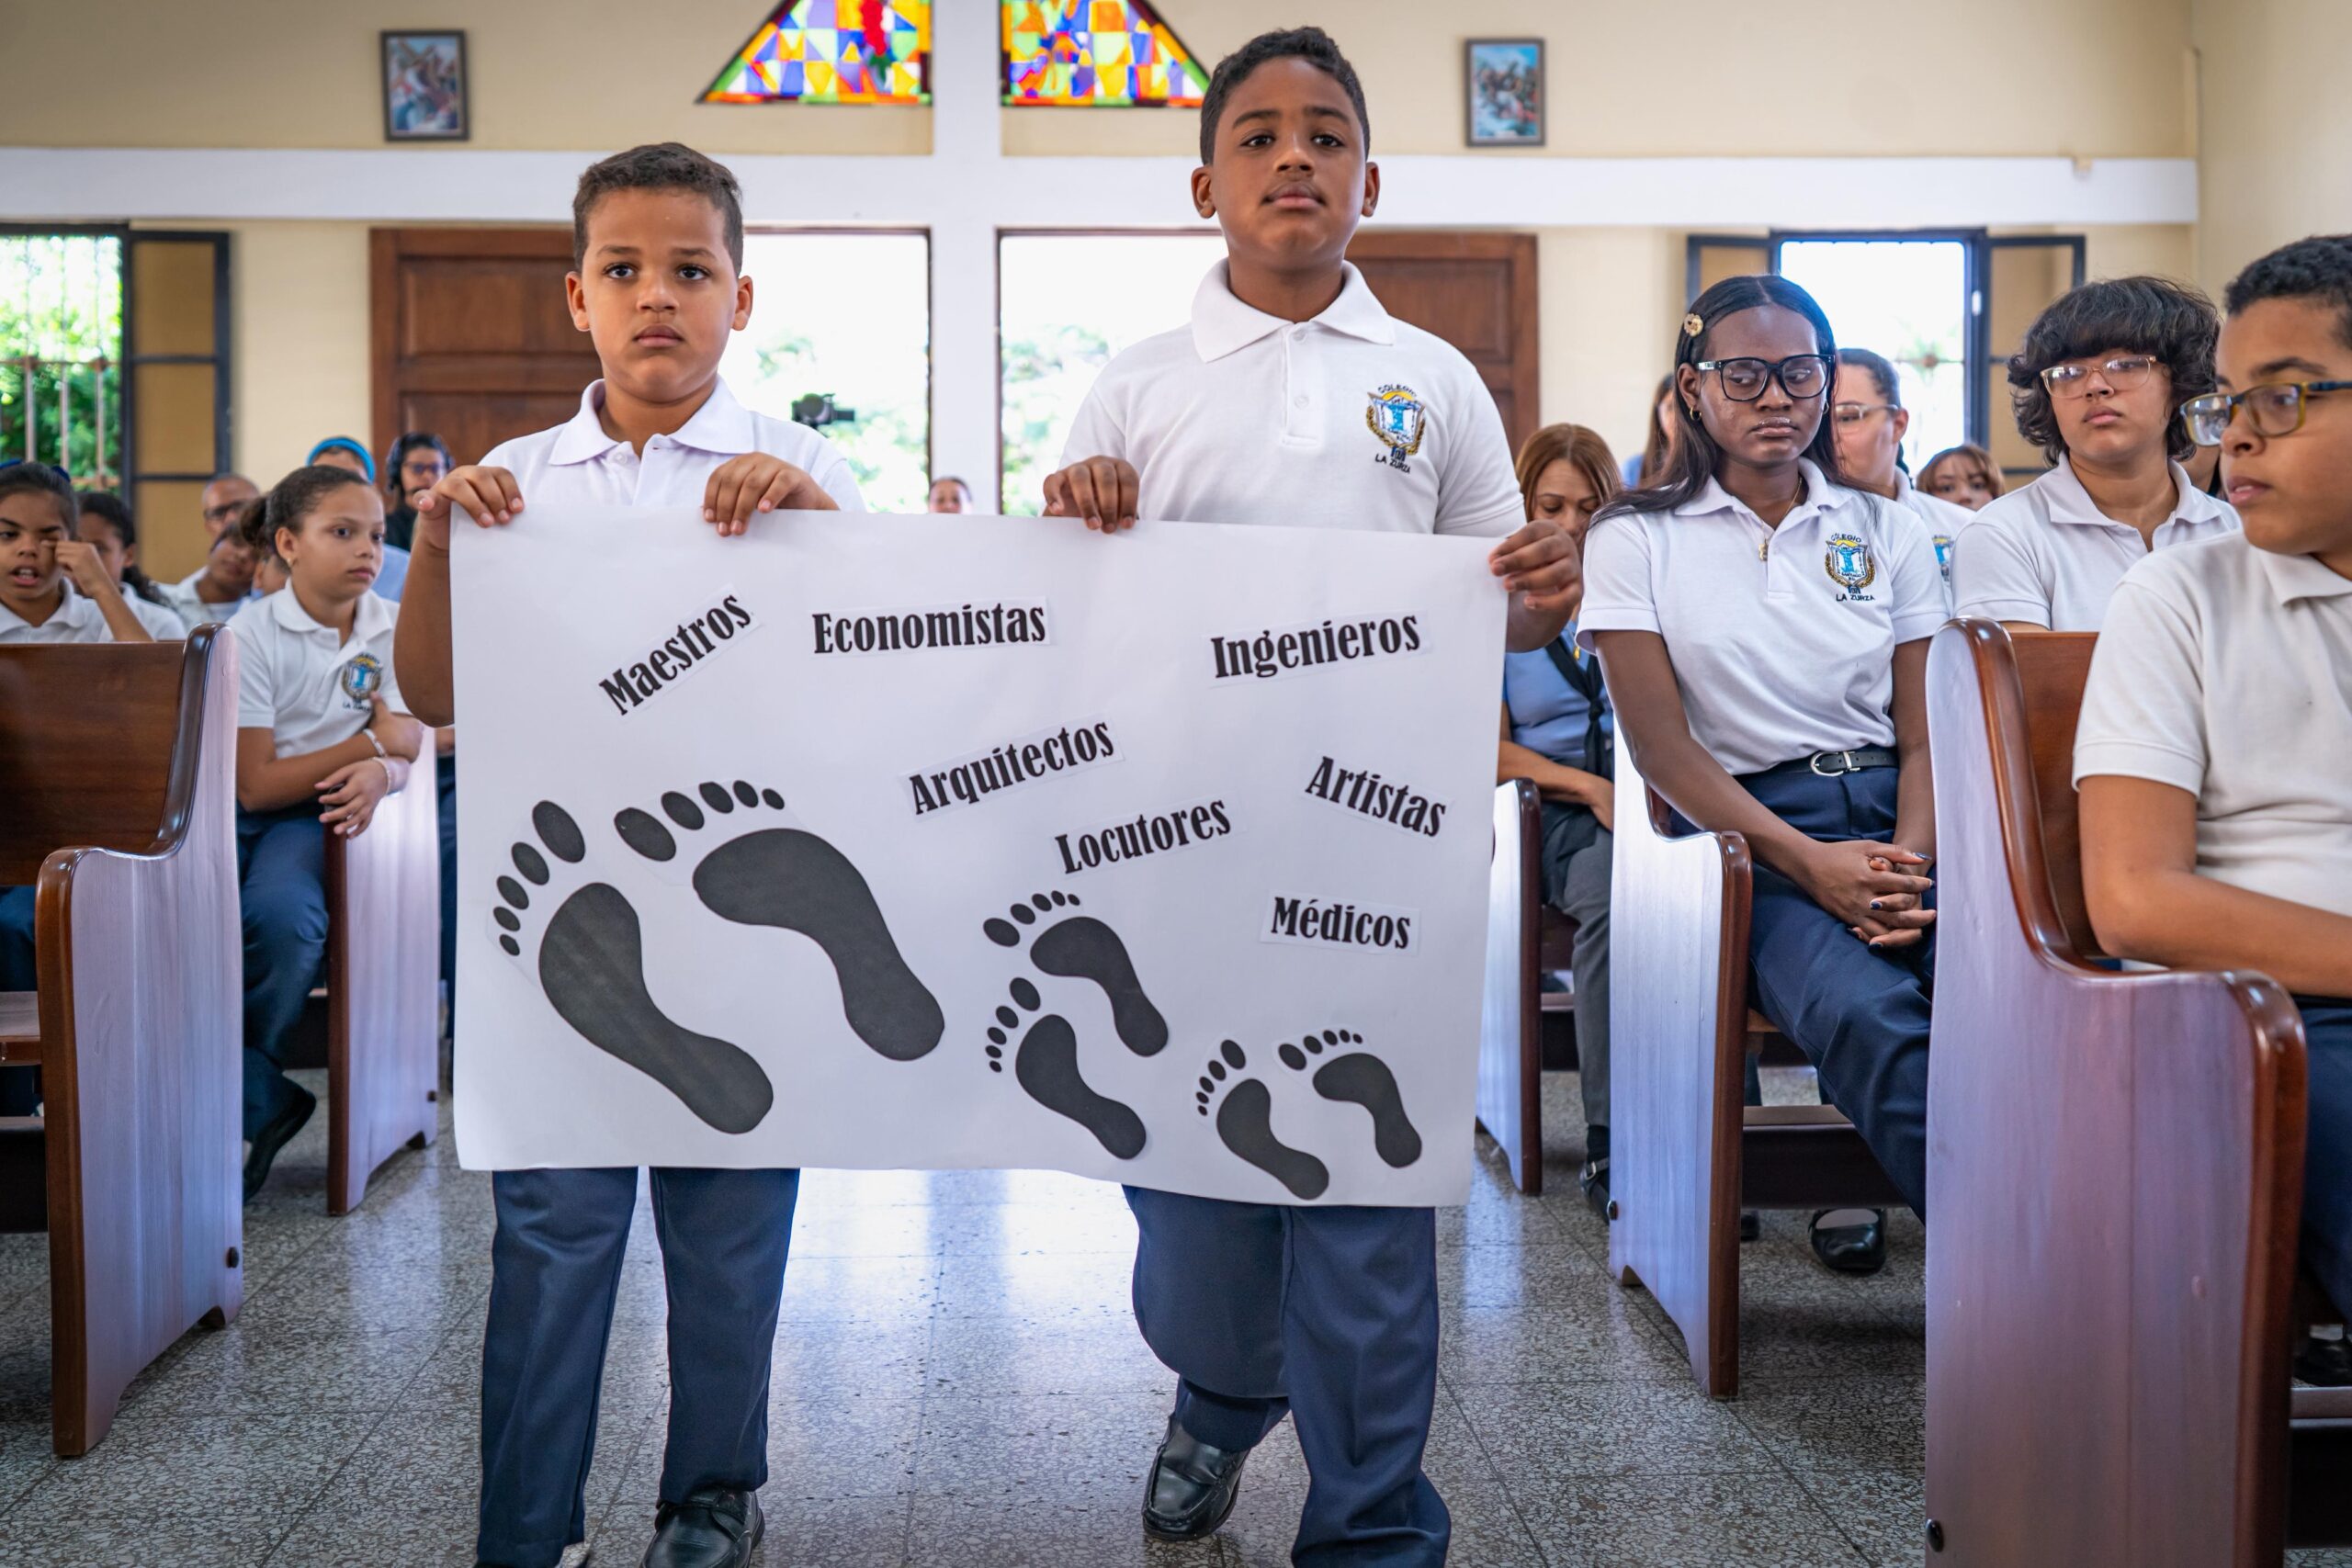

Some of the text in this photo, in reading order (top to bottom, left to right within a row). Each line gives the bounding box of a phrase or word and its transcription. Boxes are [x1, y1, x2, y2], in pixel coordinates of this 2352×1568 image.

[1374, 453, 1387, 465] LA
[1831, 533, 1862, 544] COLEGIO
[1836, 593, 1848, 602] LA
[599, 595, 750, 715] Maestros
[812, 604, 1045, 653] Economistas
[1211, 616, 1419, 678] Ingenieros
[910, 723, 1114, 815] Arquitectos
[1306, 757, 1445, 837] Artistas
[1055, 801, 1230, 874] Locutores
[1272, 897, 1409, 949] Médicos
